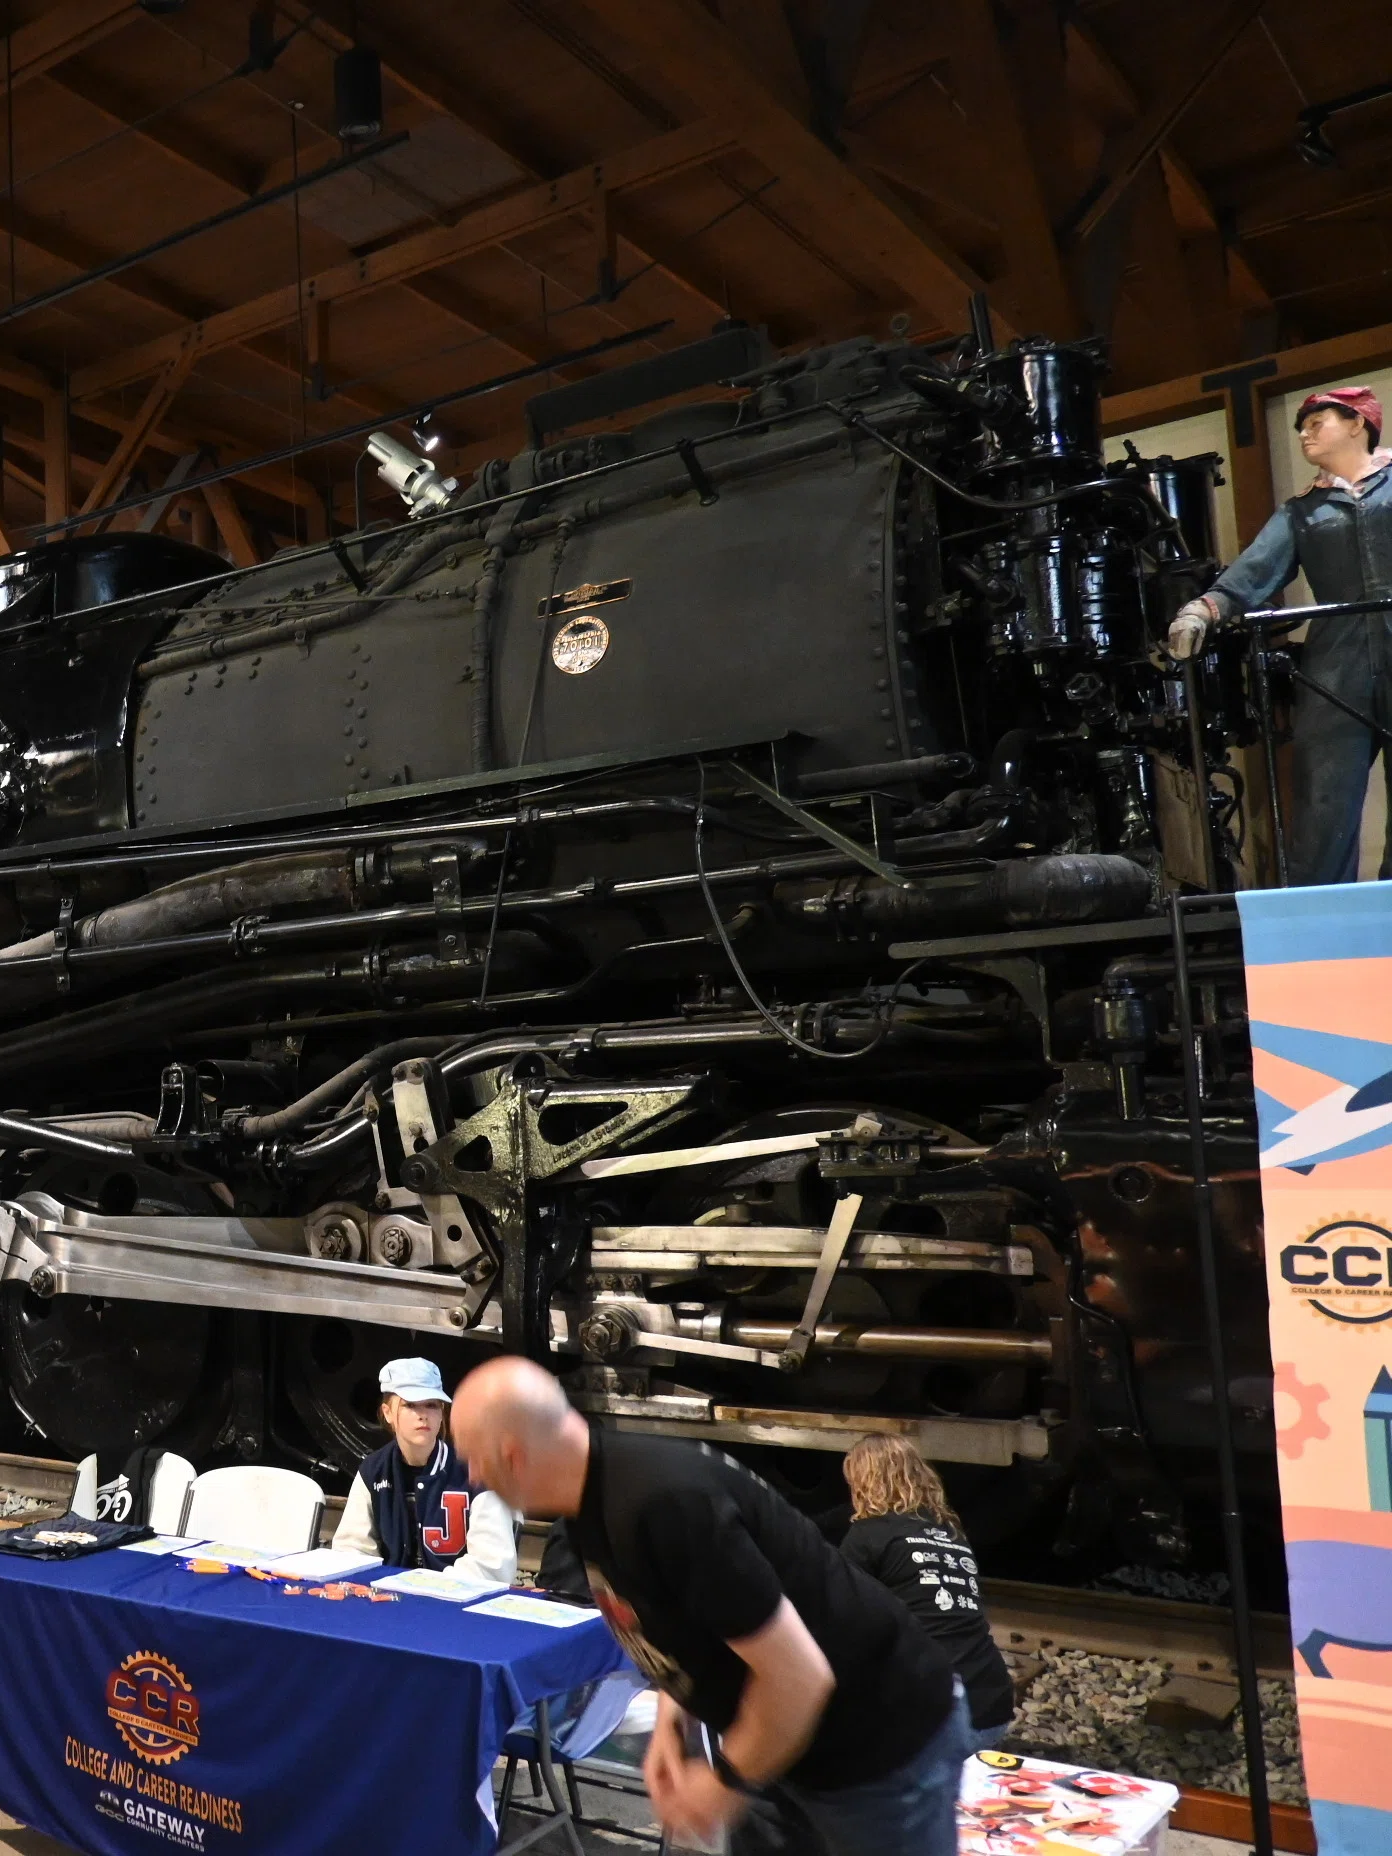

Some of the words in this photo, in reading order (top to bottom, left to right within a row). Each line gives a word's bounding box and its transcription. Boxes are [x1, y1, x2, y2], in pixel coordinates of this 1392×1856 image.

[1291, 1287, 1332, 1295] COLLEGE
[1345, 1288, 1380, 1296] CAREER
[422, 1491, 470, 1556] J
[106, 1670, 200, 1736] CCR
[65, 1735, 109, 1781] COLLEGE
[109, 1757, 134, 1789] AND
[136, 1767, 177, 1809] CAREER
[180, 1784, 243, 1835] READINESS
[123, 1798, 206, 1843] GATEWAY
[126, 1816, 166, 1839] COMMUNITY
[167, 1833, 206, 1853] CHARTERS
